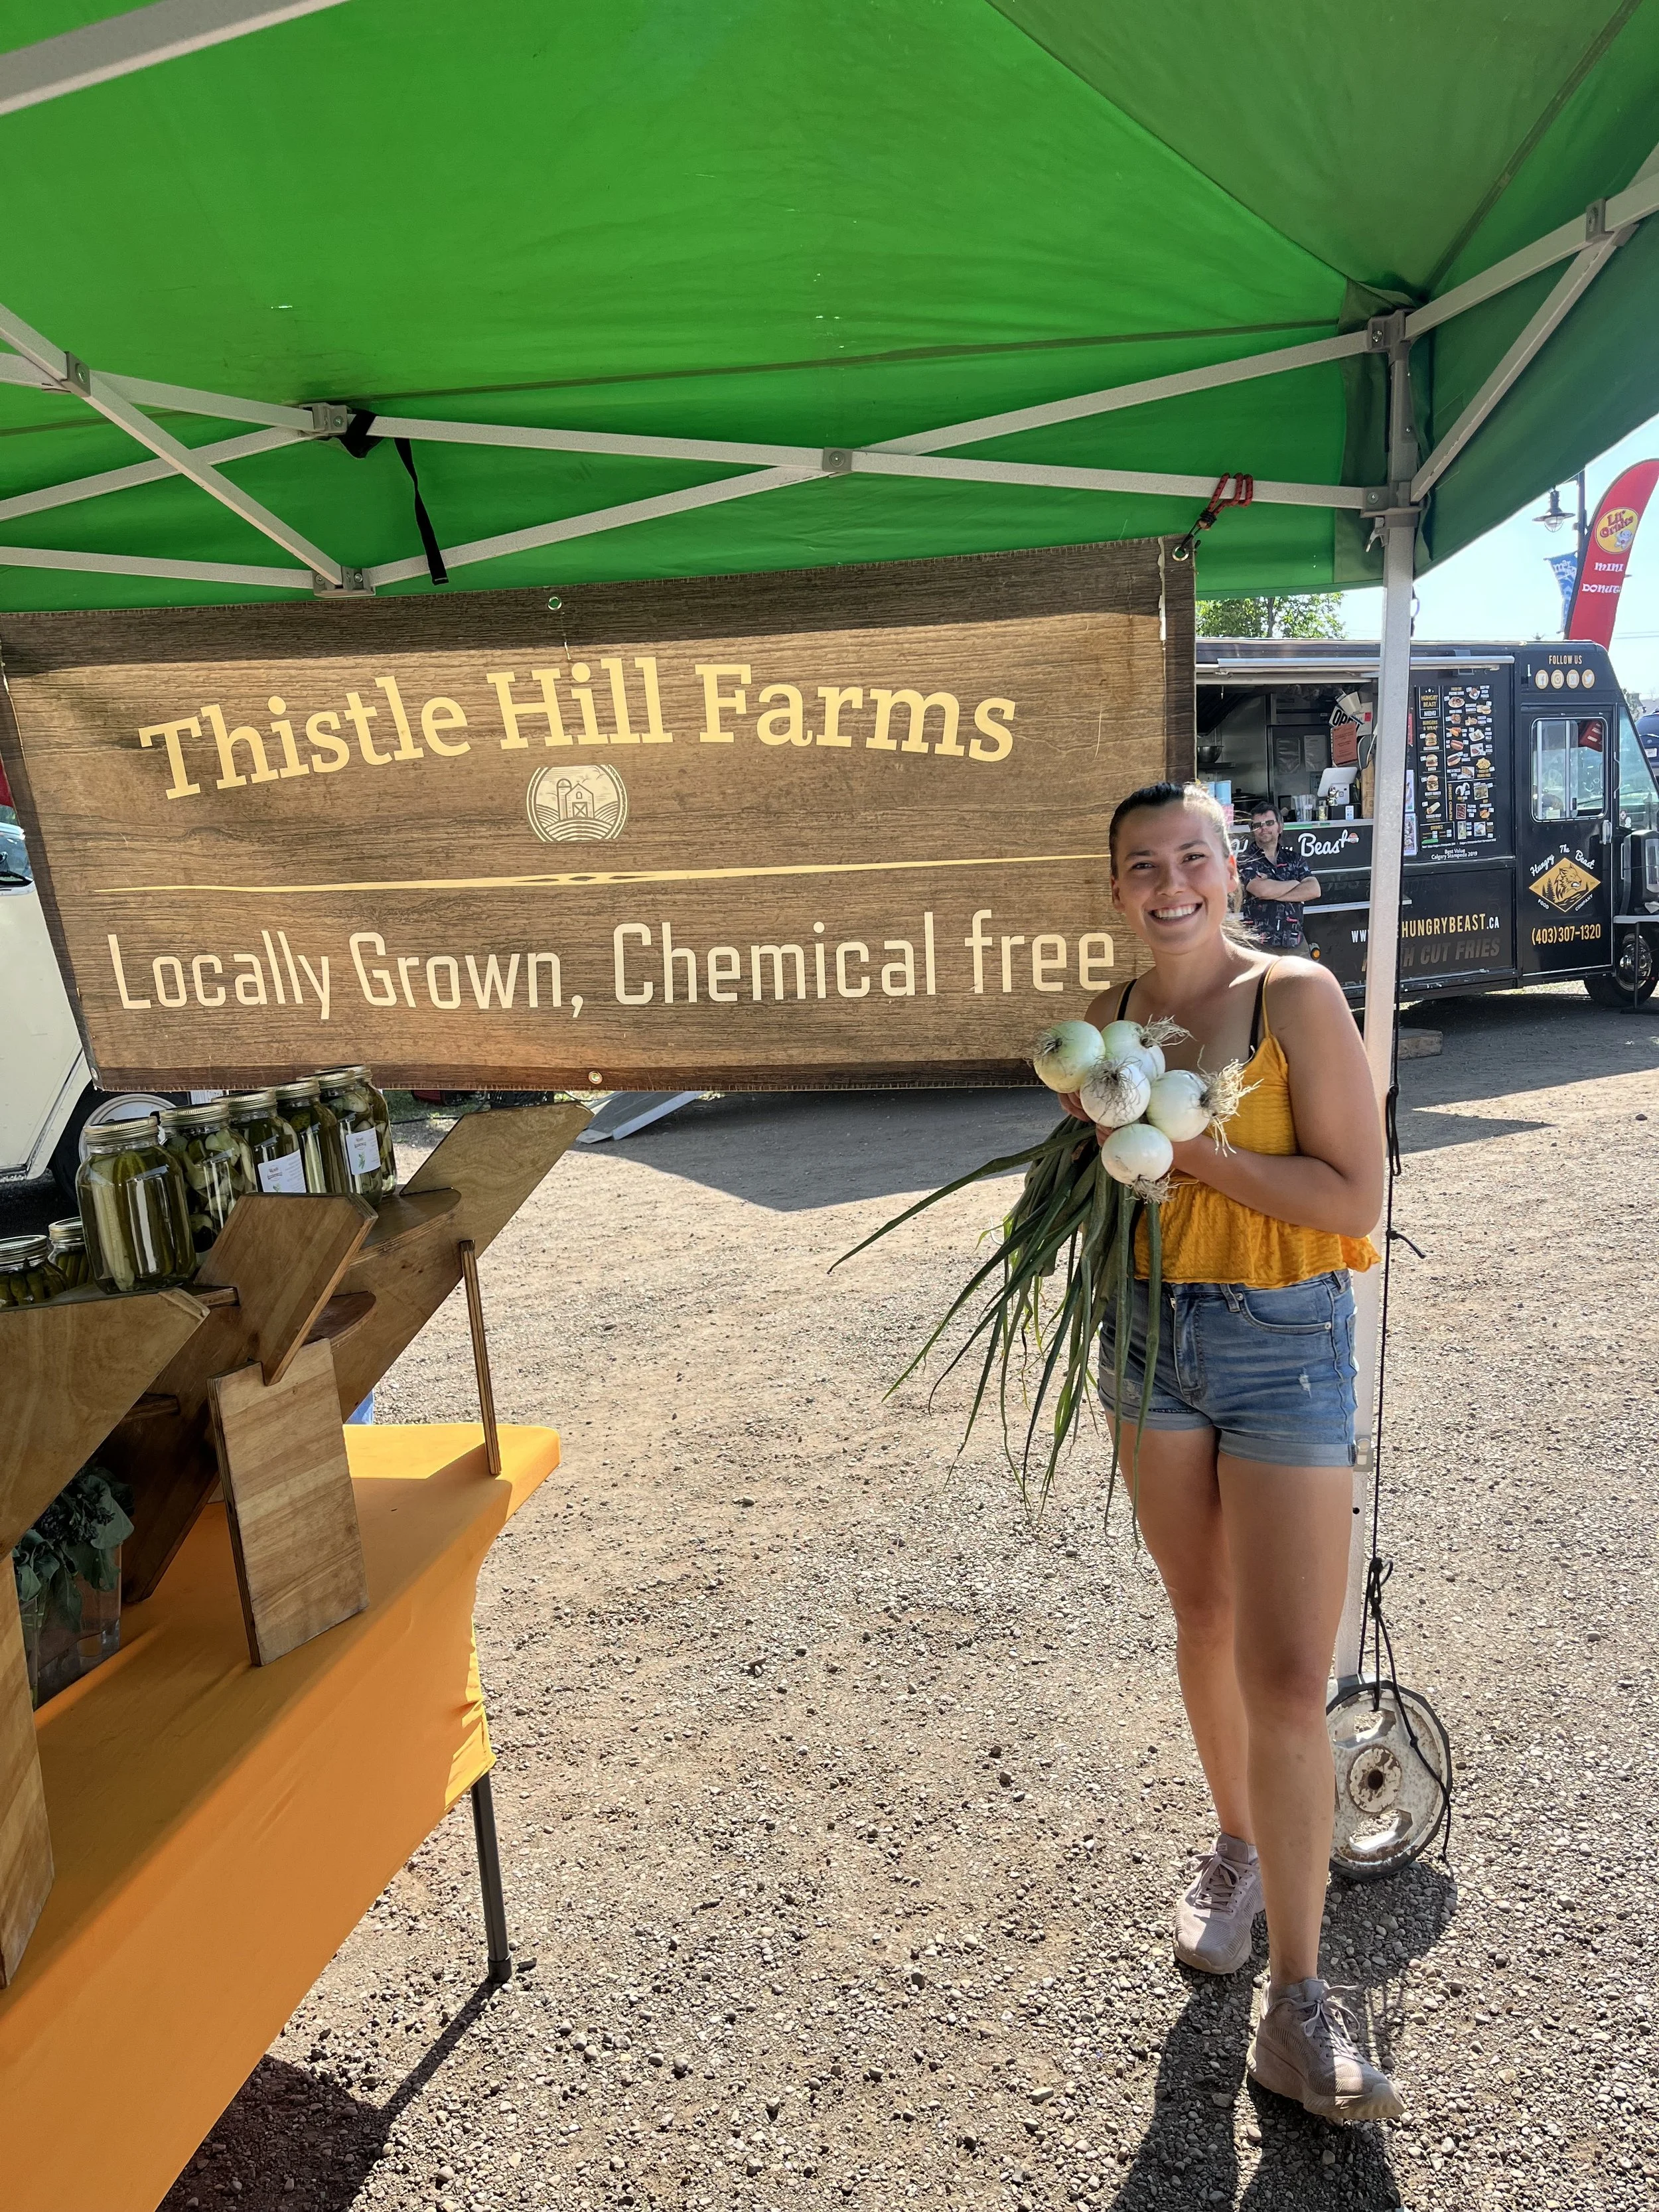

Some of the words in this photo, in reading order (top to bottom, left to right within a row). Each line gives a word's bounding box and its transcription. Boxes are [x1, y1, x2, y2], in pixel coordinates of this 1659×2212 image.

[1549, 655, 1573, 664] FOLLOW
[1574, 655, 1582, 664] US
[139, 676, 470, 800] Thistle
[486, 656, 673, 750] Hill
[695, 664, 1016, 762] Farms
[1298, 829, 1359, 857] Beast
[1530, 854, 1555, 876] Hungry
[1559, 844, 1570, 853] The
[1575, 849, 1595, 869] Beast
[1538, 899, 1550, 909] FOOD
[1575, 894, 1593, 911] COMPANY
[108, 930, 330, 1020] Locally
[348, 932, 584, 1019] Grown,
[613, 912, 936, 1005] Chemical
[964, 909, 1115, 994] free
[1420, 942, 1451, 965] CUT
[1455, 937, 1501, 960] FRIES
